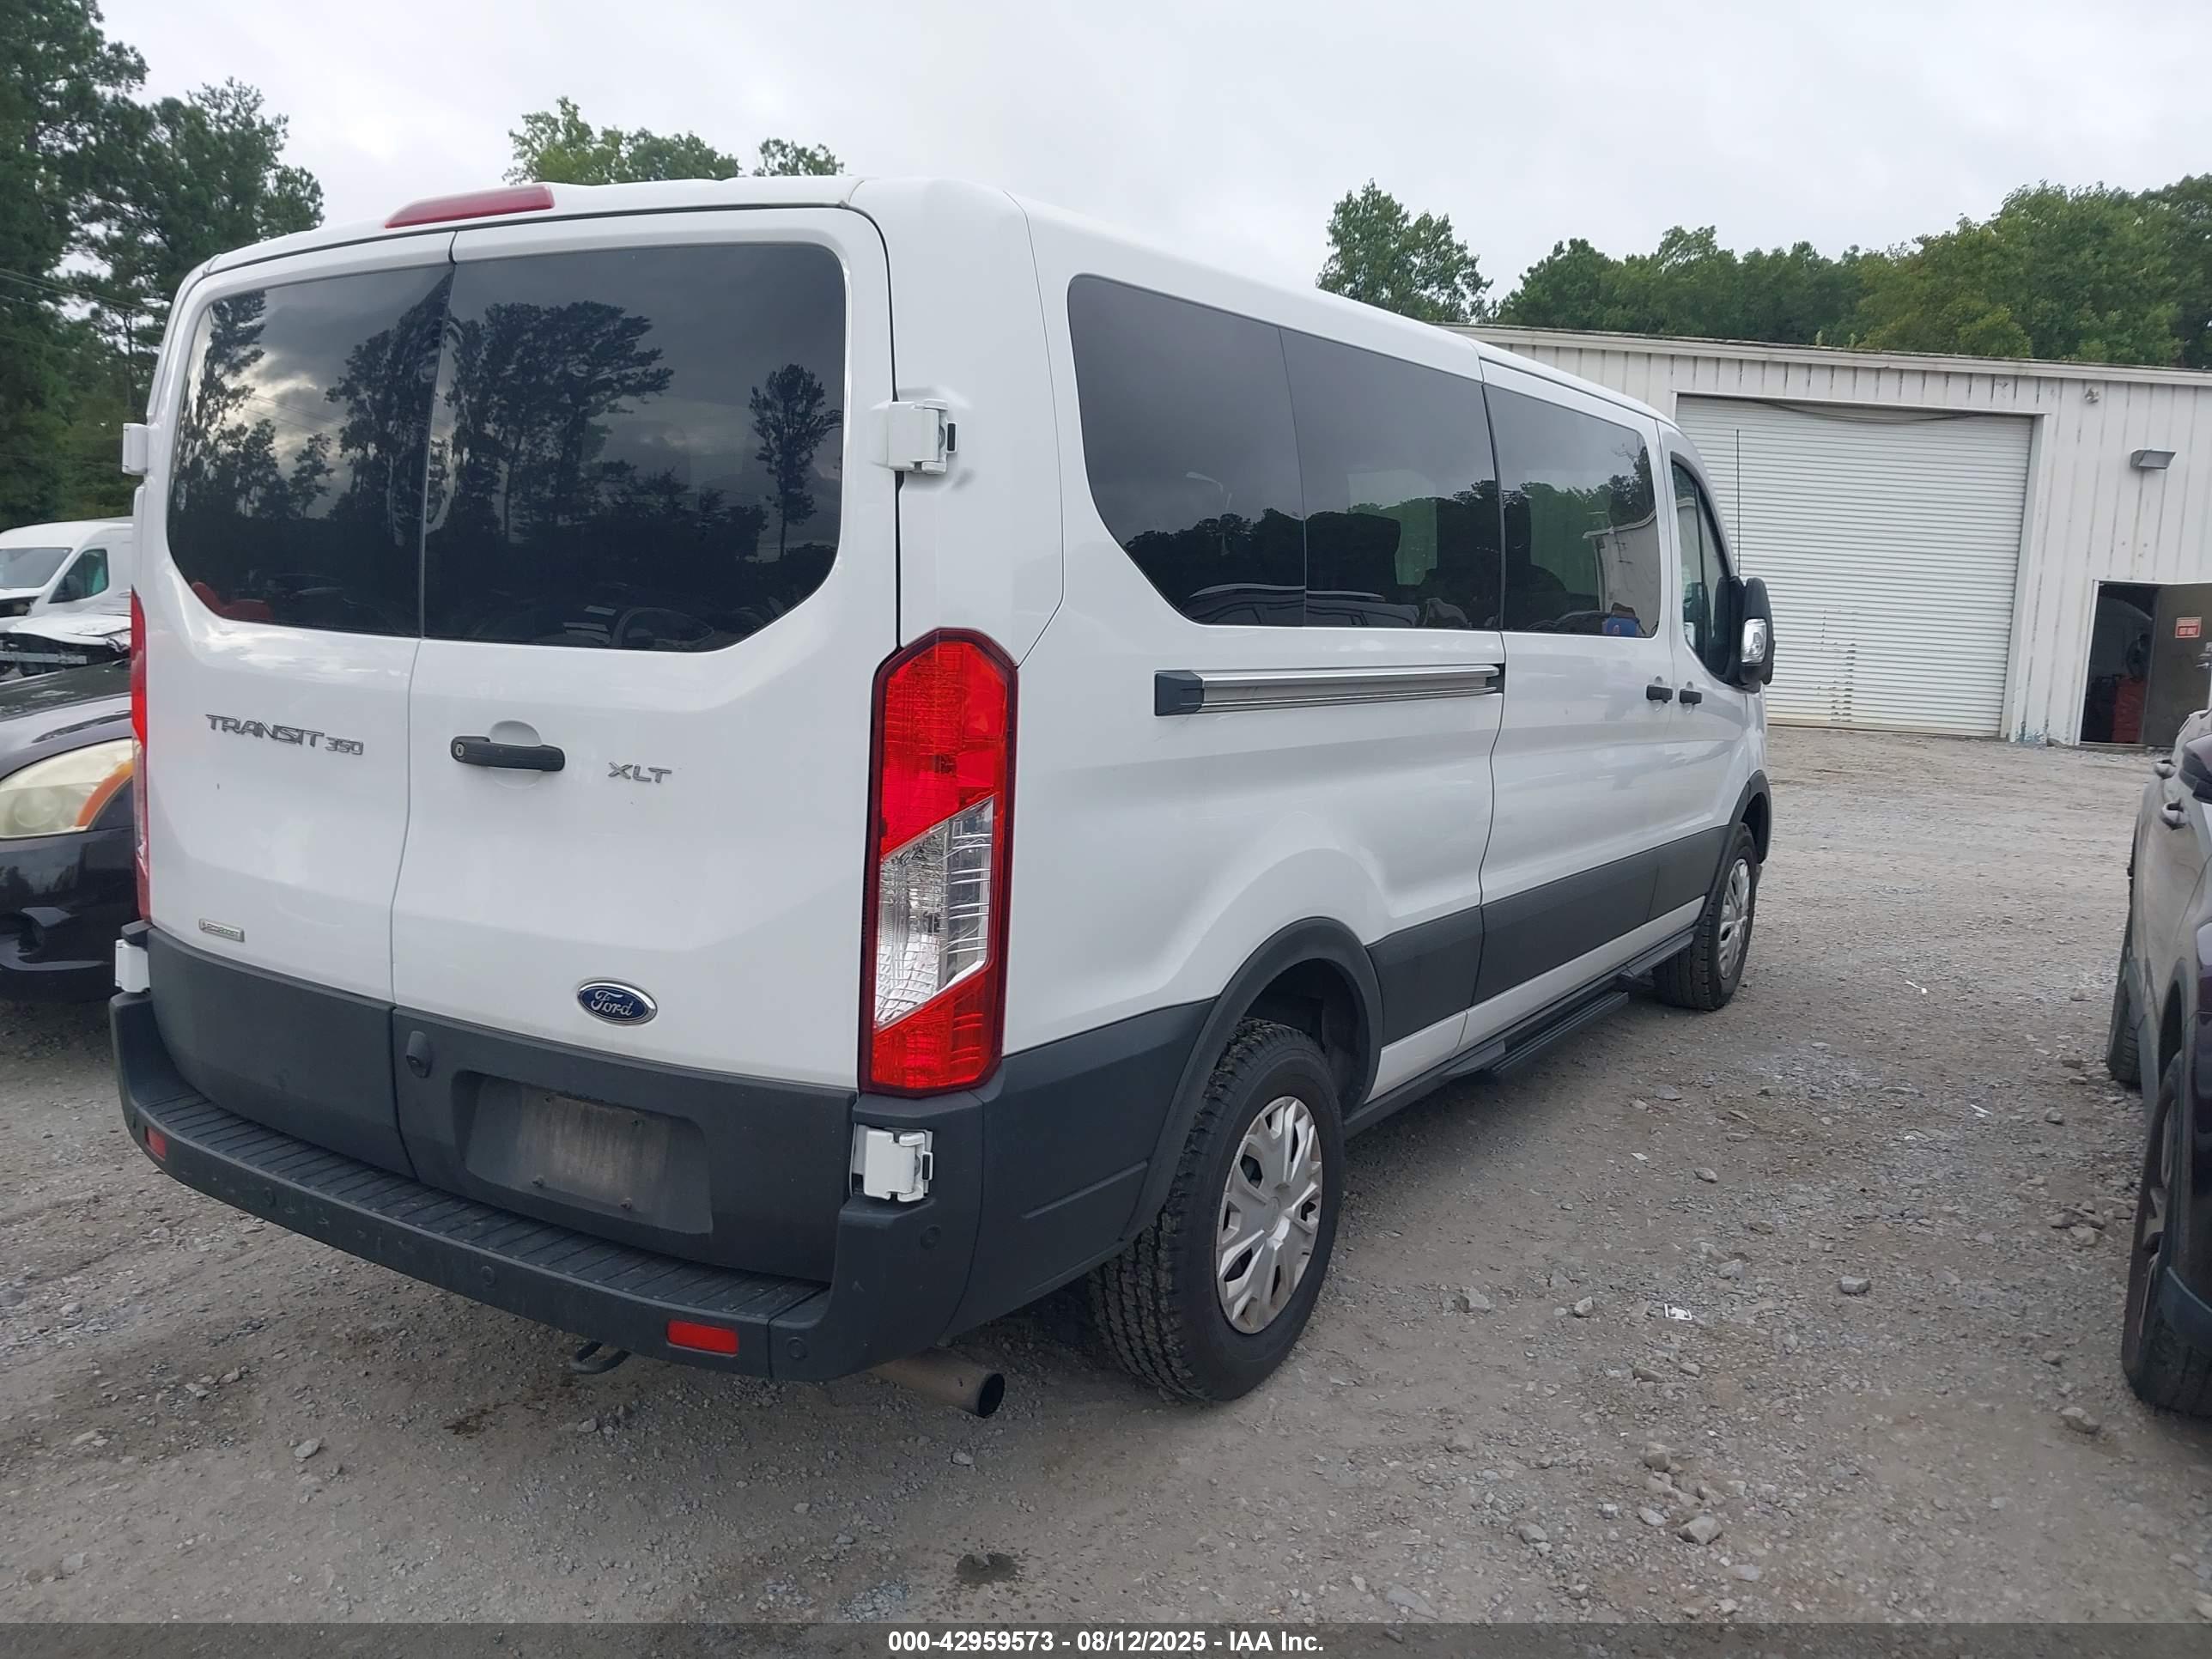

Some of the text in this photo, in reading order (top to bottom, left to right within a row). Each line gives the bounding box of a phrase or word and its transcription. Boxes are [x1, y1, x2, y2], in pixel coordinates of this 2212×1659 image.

[205, 714, 364, 756] TRANSIT 350
[607, 762, 672, 784] XLT
[590, 989, 634, 1017] Ford
